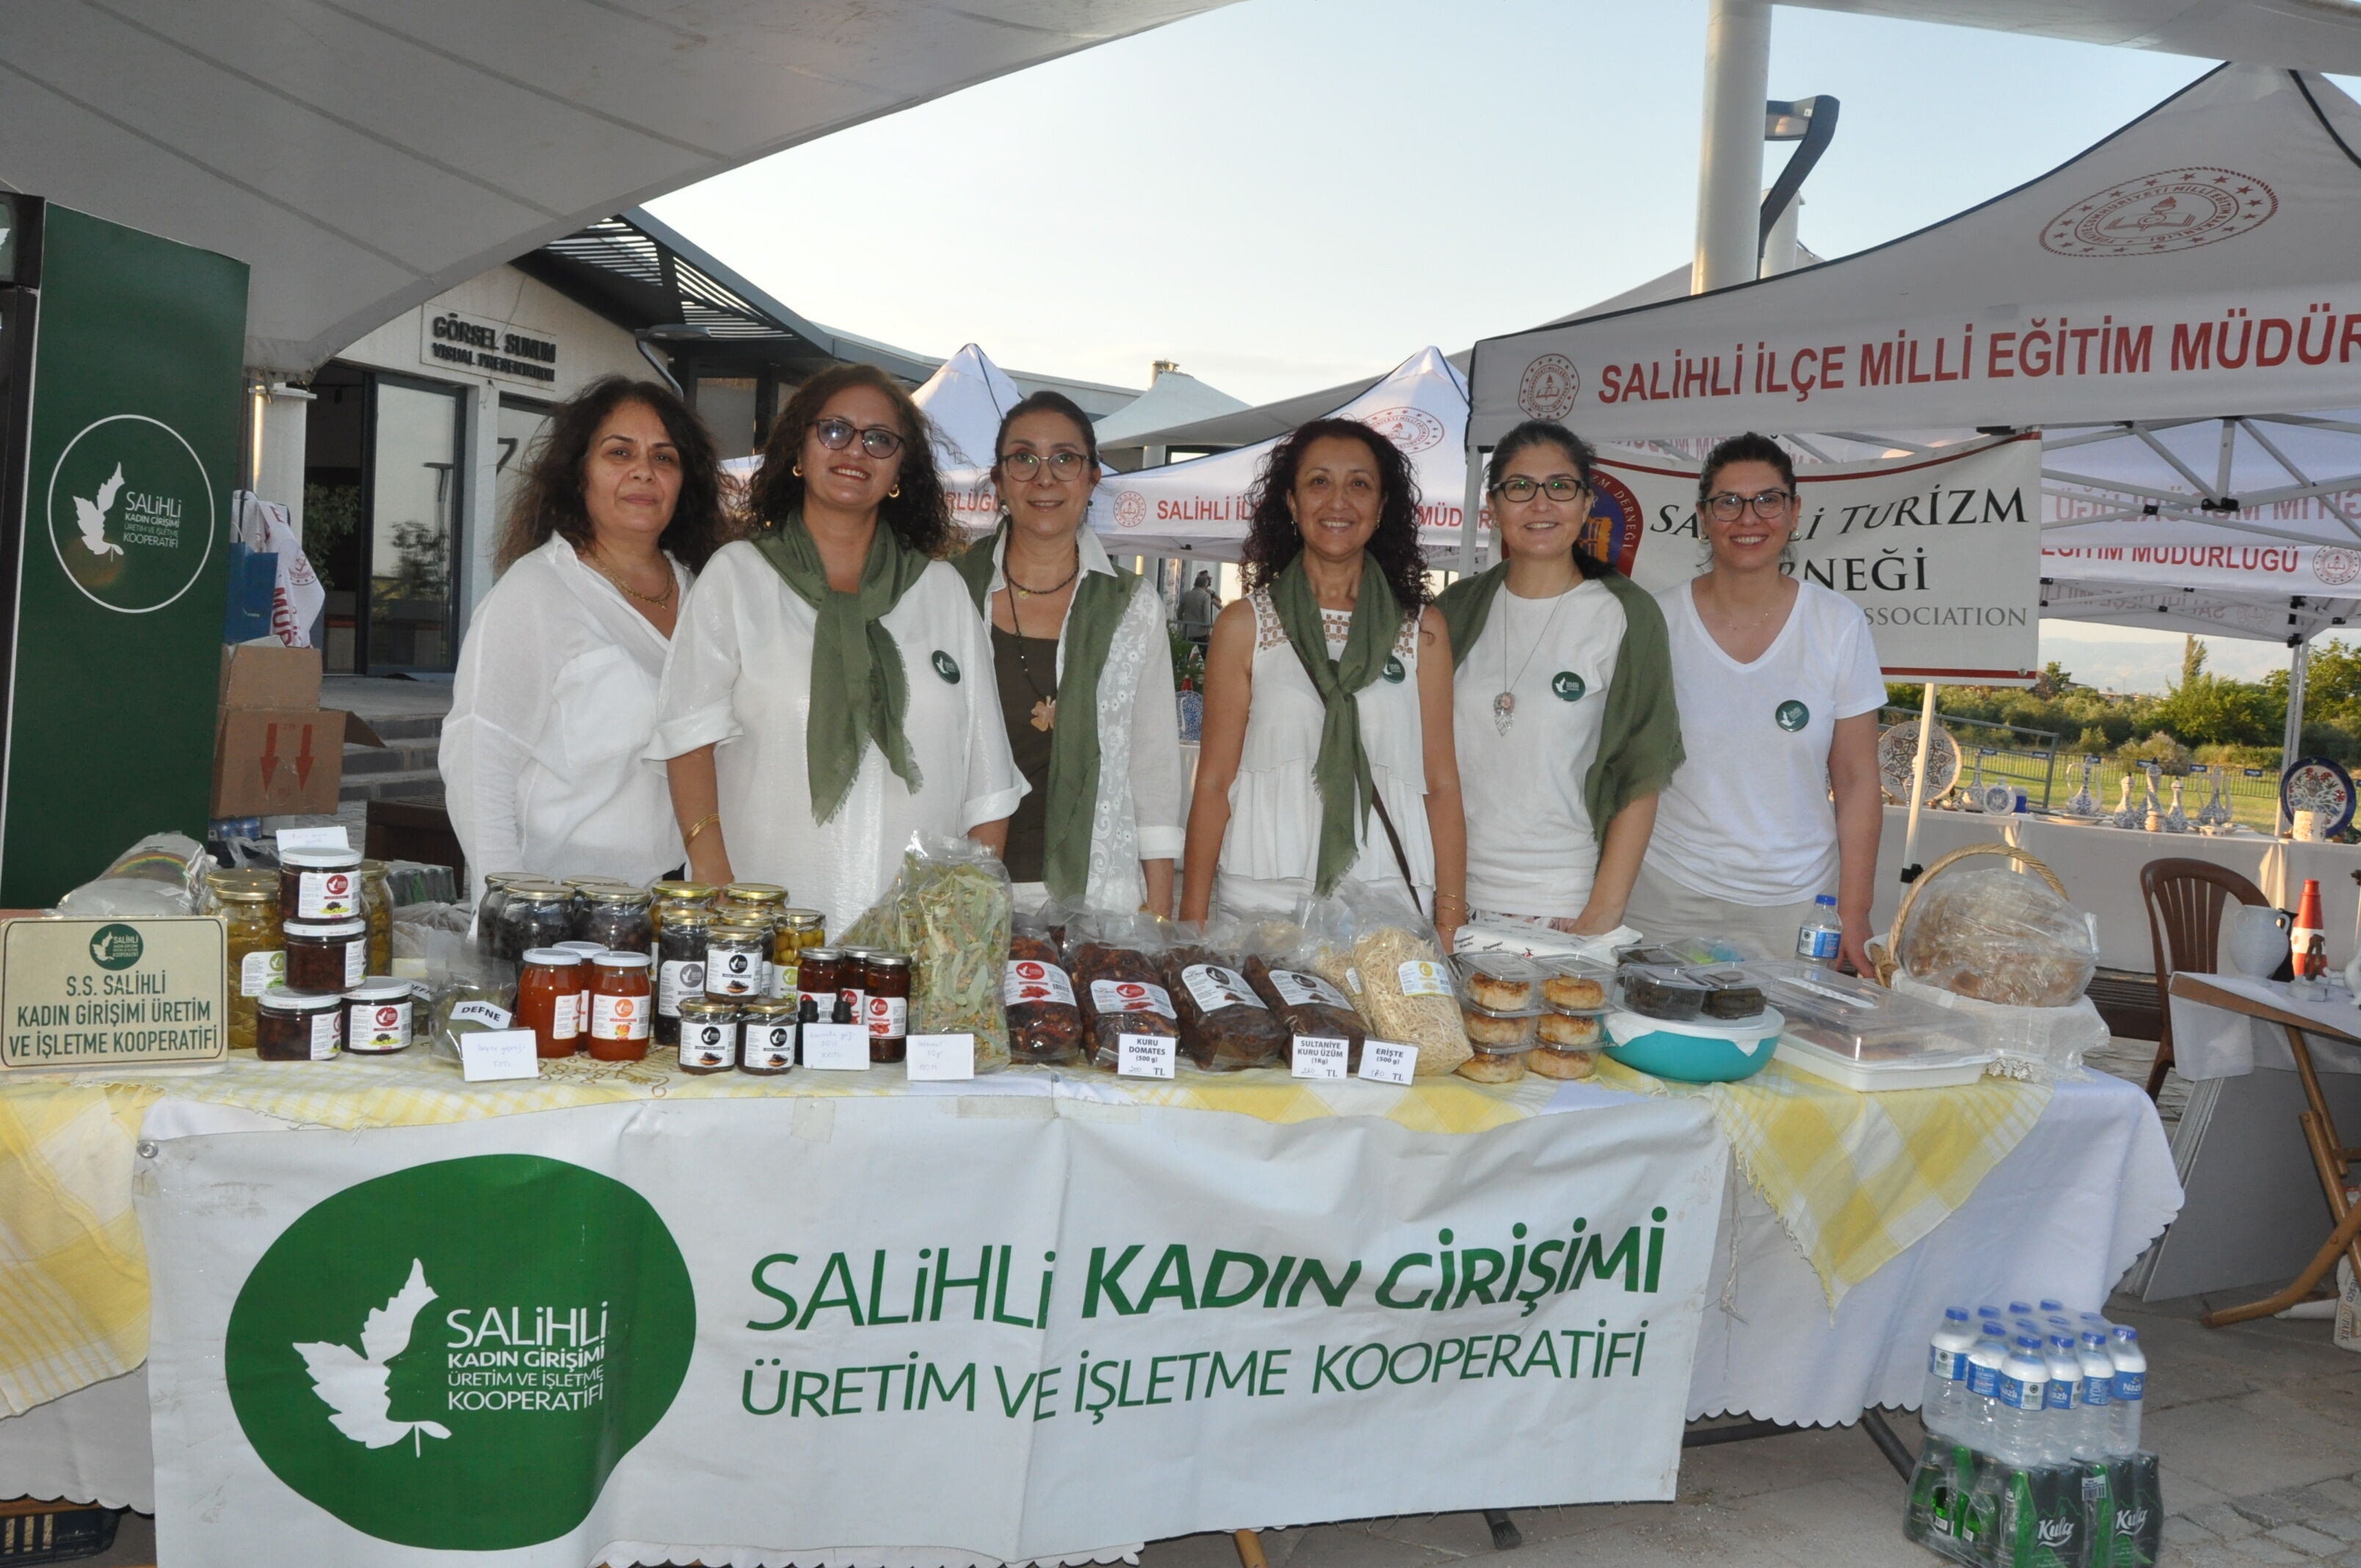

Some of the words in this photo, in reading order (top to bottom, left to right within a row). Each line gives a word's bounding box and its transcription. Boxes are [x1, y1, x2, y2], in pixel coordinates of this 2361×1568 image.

[432, 312, 499, 350] GÖRSEL
[1598, 343, 1744, 404] SALİHLİ
[1755, 341, 1846, 402] İLÇE
[1860, 323, 1973, 387] MİLLİ
[1987, 315, 2154, 379] EĞİTİM
[125, 512, 150, 524] KADIN
[1156, 496, 1230, 520] SALİHLİ
[1838, 483, 2029, 536] TURİZM
[1863, 606, 2028, 626] SSOCIATION
[66, 976, 97, 996] S.S.
[104, 970, 166, 995] SALİHLİ
[18, 1005, 70, 1027] KADIN
[76, 998, 145, 1027] GİRİŞİMİ
[151, 997, 210, 1022] ÜRETİM
[461, 1006, 501, 1022] DEFNE
[9, 1036, 30, 1057] VE
[37, 1031, 108, 1059] İŞLETME
[113, 1025, 217, 1053] KOOPERATİFİ
[1128, 1046, 1166, 1056] DOMATES
[1136, 1038, 1158, 1046] KURU
[1297, 1048, 1318, 1056] KURU
[1321, 1050, 1343, 1058] ÜZÜM
[1301, 1040, 1341, 1049] SULTANİYE
[1376, 1048, 1404, 1058] ERİŞTE
[1153, 1067, 1166, 1076] TL
[1326, 1070, 1338, 1078] TL
[1393, 1072, 1404, 1081] TL
[1081, 1243, 1363, 1319] KADIN
[1374, 1205, 1668, 1318] GİRİŞİMİ
[448, 1351, 518, 1368] KADIN
[524, 1340, 606, 1372] GİRİŞİMİ
[448, 1368, 512, 1387] ÜRETİM
[517, 1372, 537, 1387] VE
[542, 1364, 604, 1390] İŞLETME
[741, 1351, 976, 1418] ÜRETİM
[993, 1365, 1062, 1423] VE
[1074, 1349, 1292, 1426] İŞLETME
[1311, 1318, 1649, 1394] KOOPERATİFİ
[448, 1377, 604, 1412] KOOPERATİFİ
[2037, 1516, 2075, 1543] Kula
[2115, 1506, 2149, 1531] Kula
